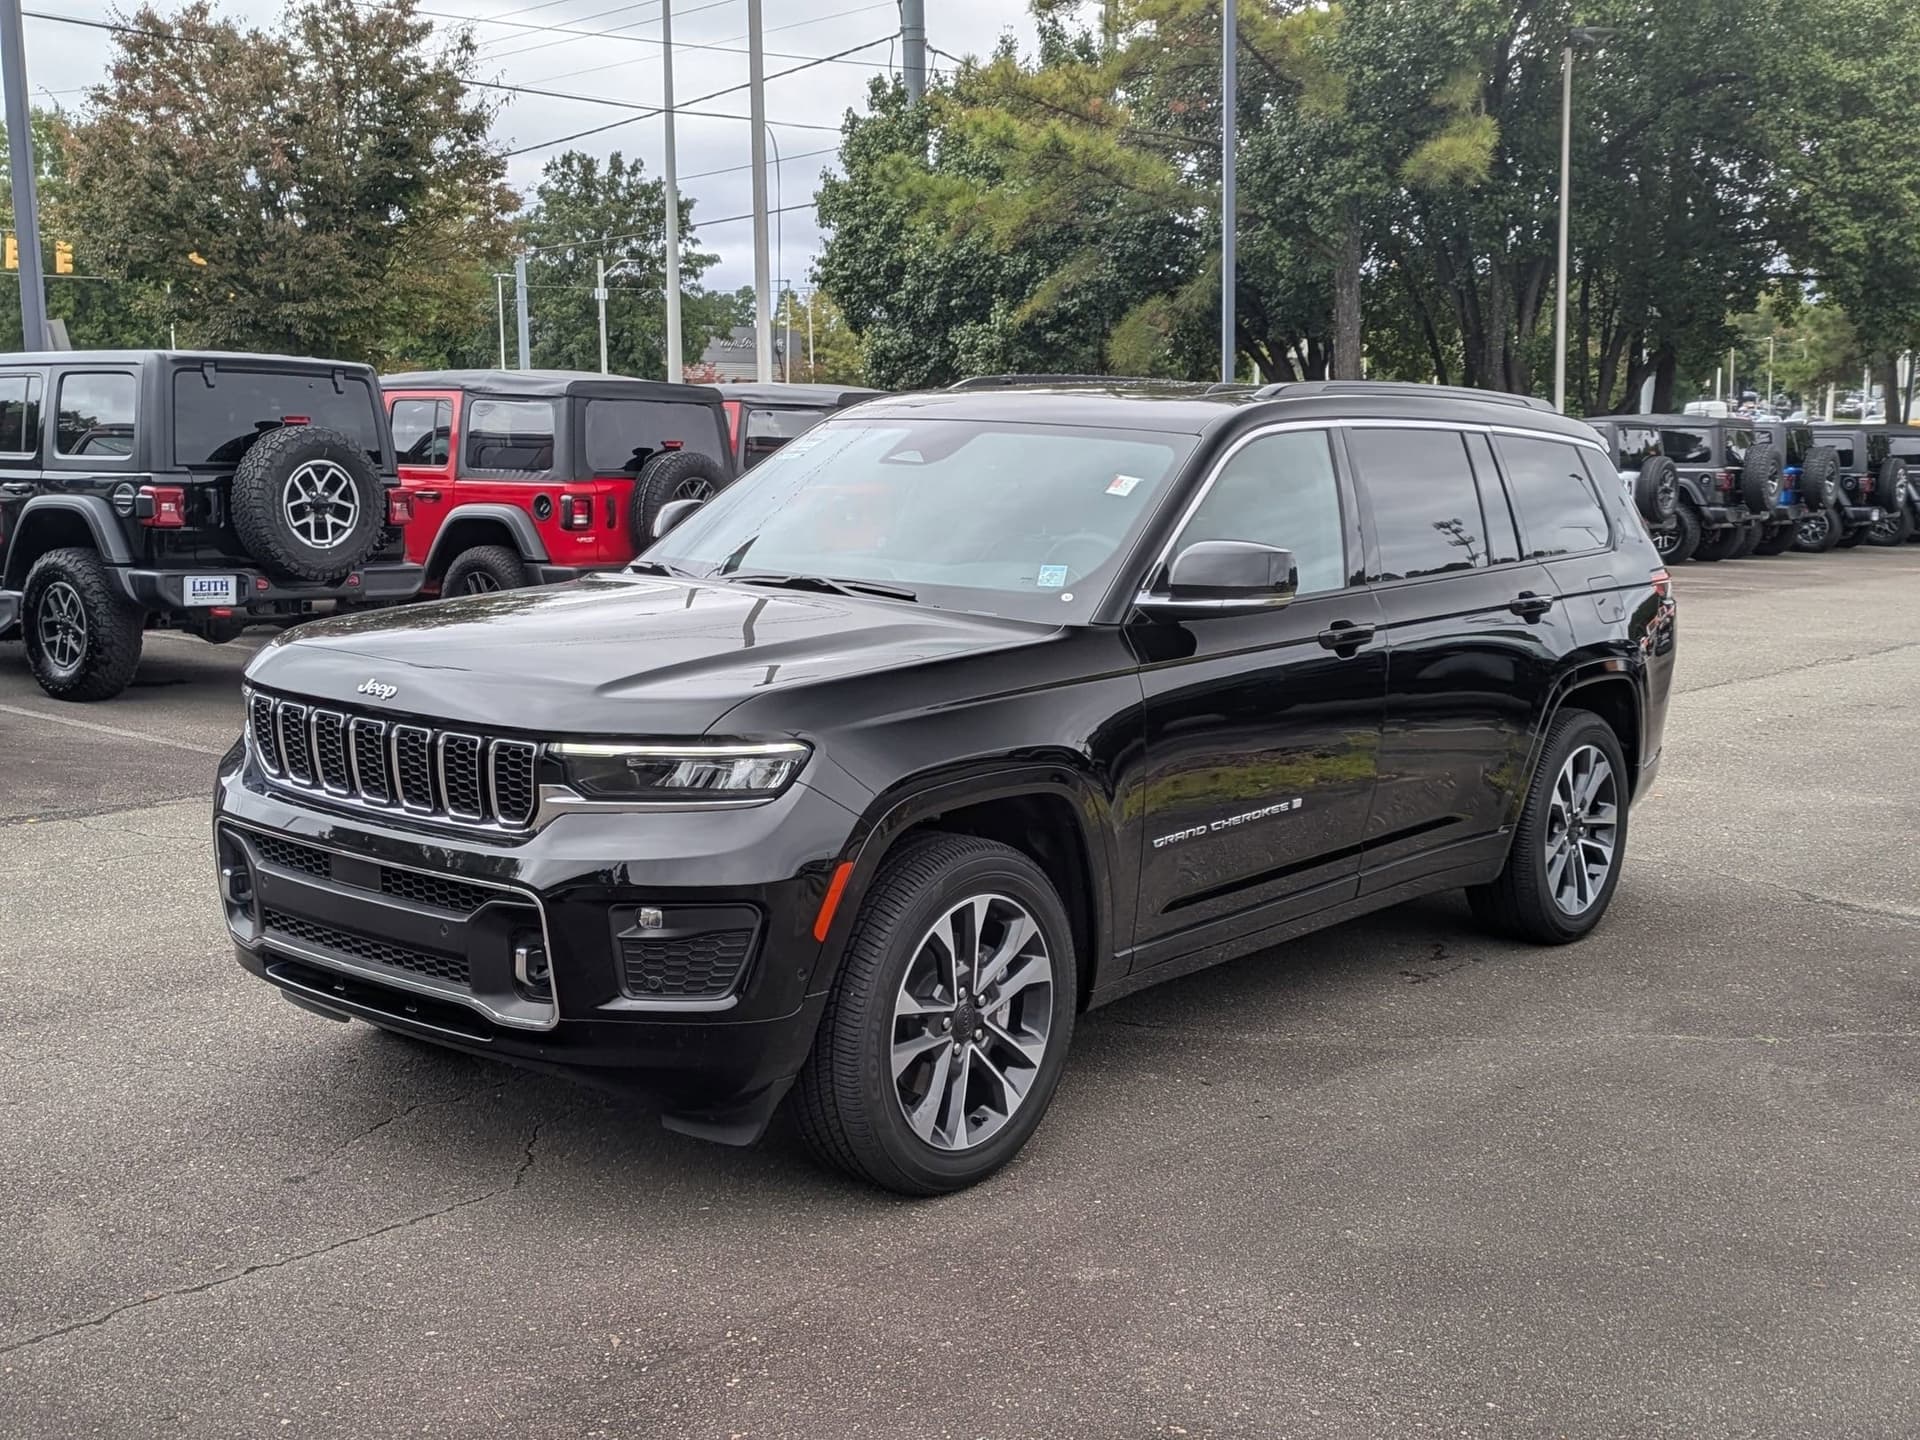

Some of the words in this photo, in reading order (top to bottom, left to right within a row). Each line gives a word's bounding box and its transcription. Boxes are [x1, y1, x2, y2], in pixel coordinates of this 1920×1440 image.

[192, 580, 229, 592] LEITH
[357, 678, 398, 700] Jeep
[1152, 825, 1207, 848] GRAND
[1210, 802, 1289, 831] CHEROKEE
